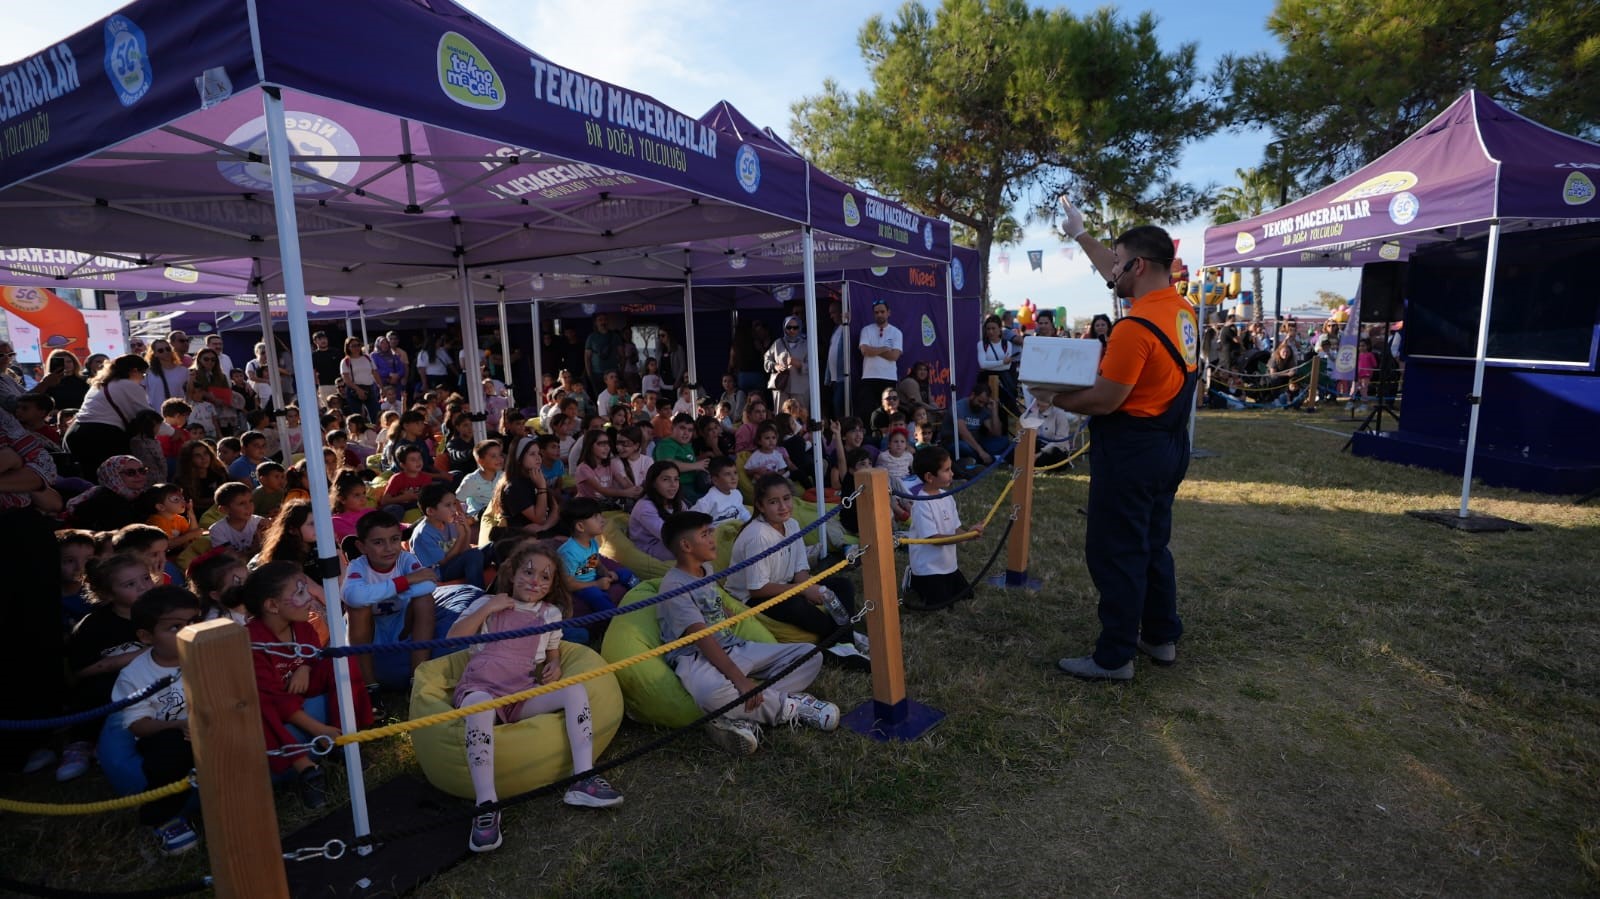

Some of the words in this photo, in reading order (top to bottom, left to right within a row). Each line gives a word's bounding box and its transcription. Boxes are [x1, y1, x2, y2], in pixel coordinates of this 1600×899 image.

[450, 53, 493, 83] tekno
[447, 70, 499, 102] macera
[530, 57, 603, 118] TEKNO
[608, 87, 717, 159] MACERACILAR
[586, 119, 602, 149] BİR
[607, 128, 635, 158] DOĞA
[639, 137, 687, 173] YOLCULUĞU
[1294, 200, 1371, 231] MACERACILAR
